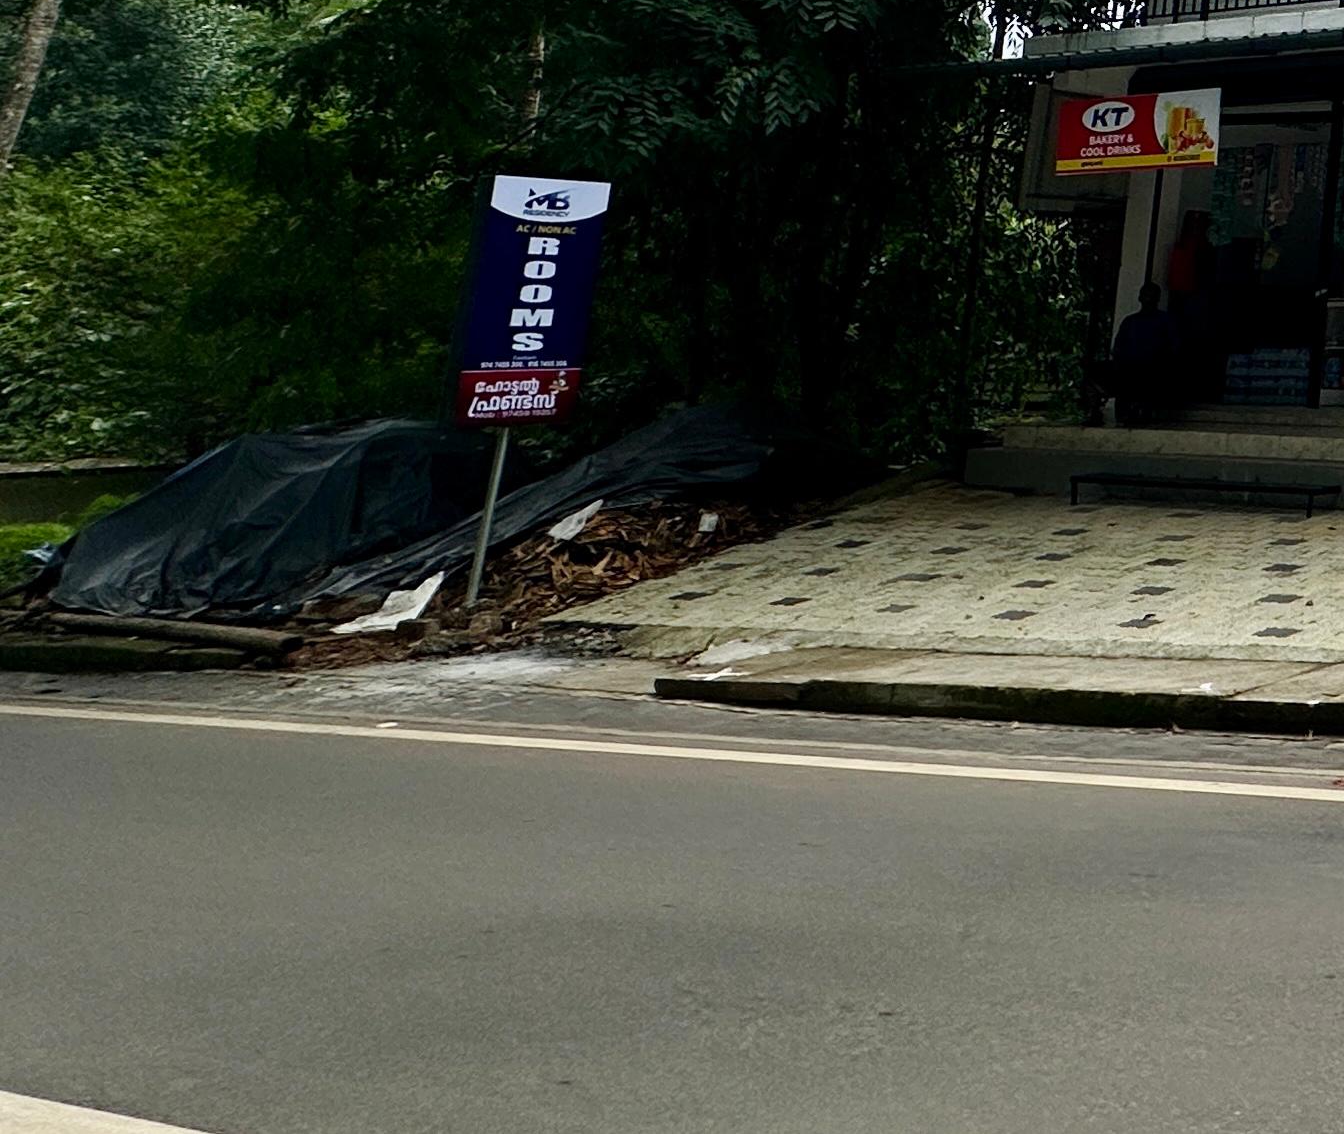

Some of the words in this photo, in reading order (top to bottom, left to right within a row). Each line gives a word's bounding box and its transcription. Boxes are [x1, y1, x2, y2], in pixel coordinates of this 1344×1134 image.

[1090, 107, 1130, 128] KT
[1088, 134, 1126, 146] BAKERY
[1126, 133, 1134, 143] &
[1080, 146, 1105, 157] COOL
[1106, 144, 1142, 156] DRINKS
[516, 224, 532, 233] AC
[509, 236, 560, 352] ROOMS
